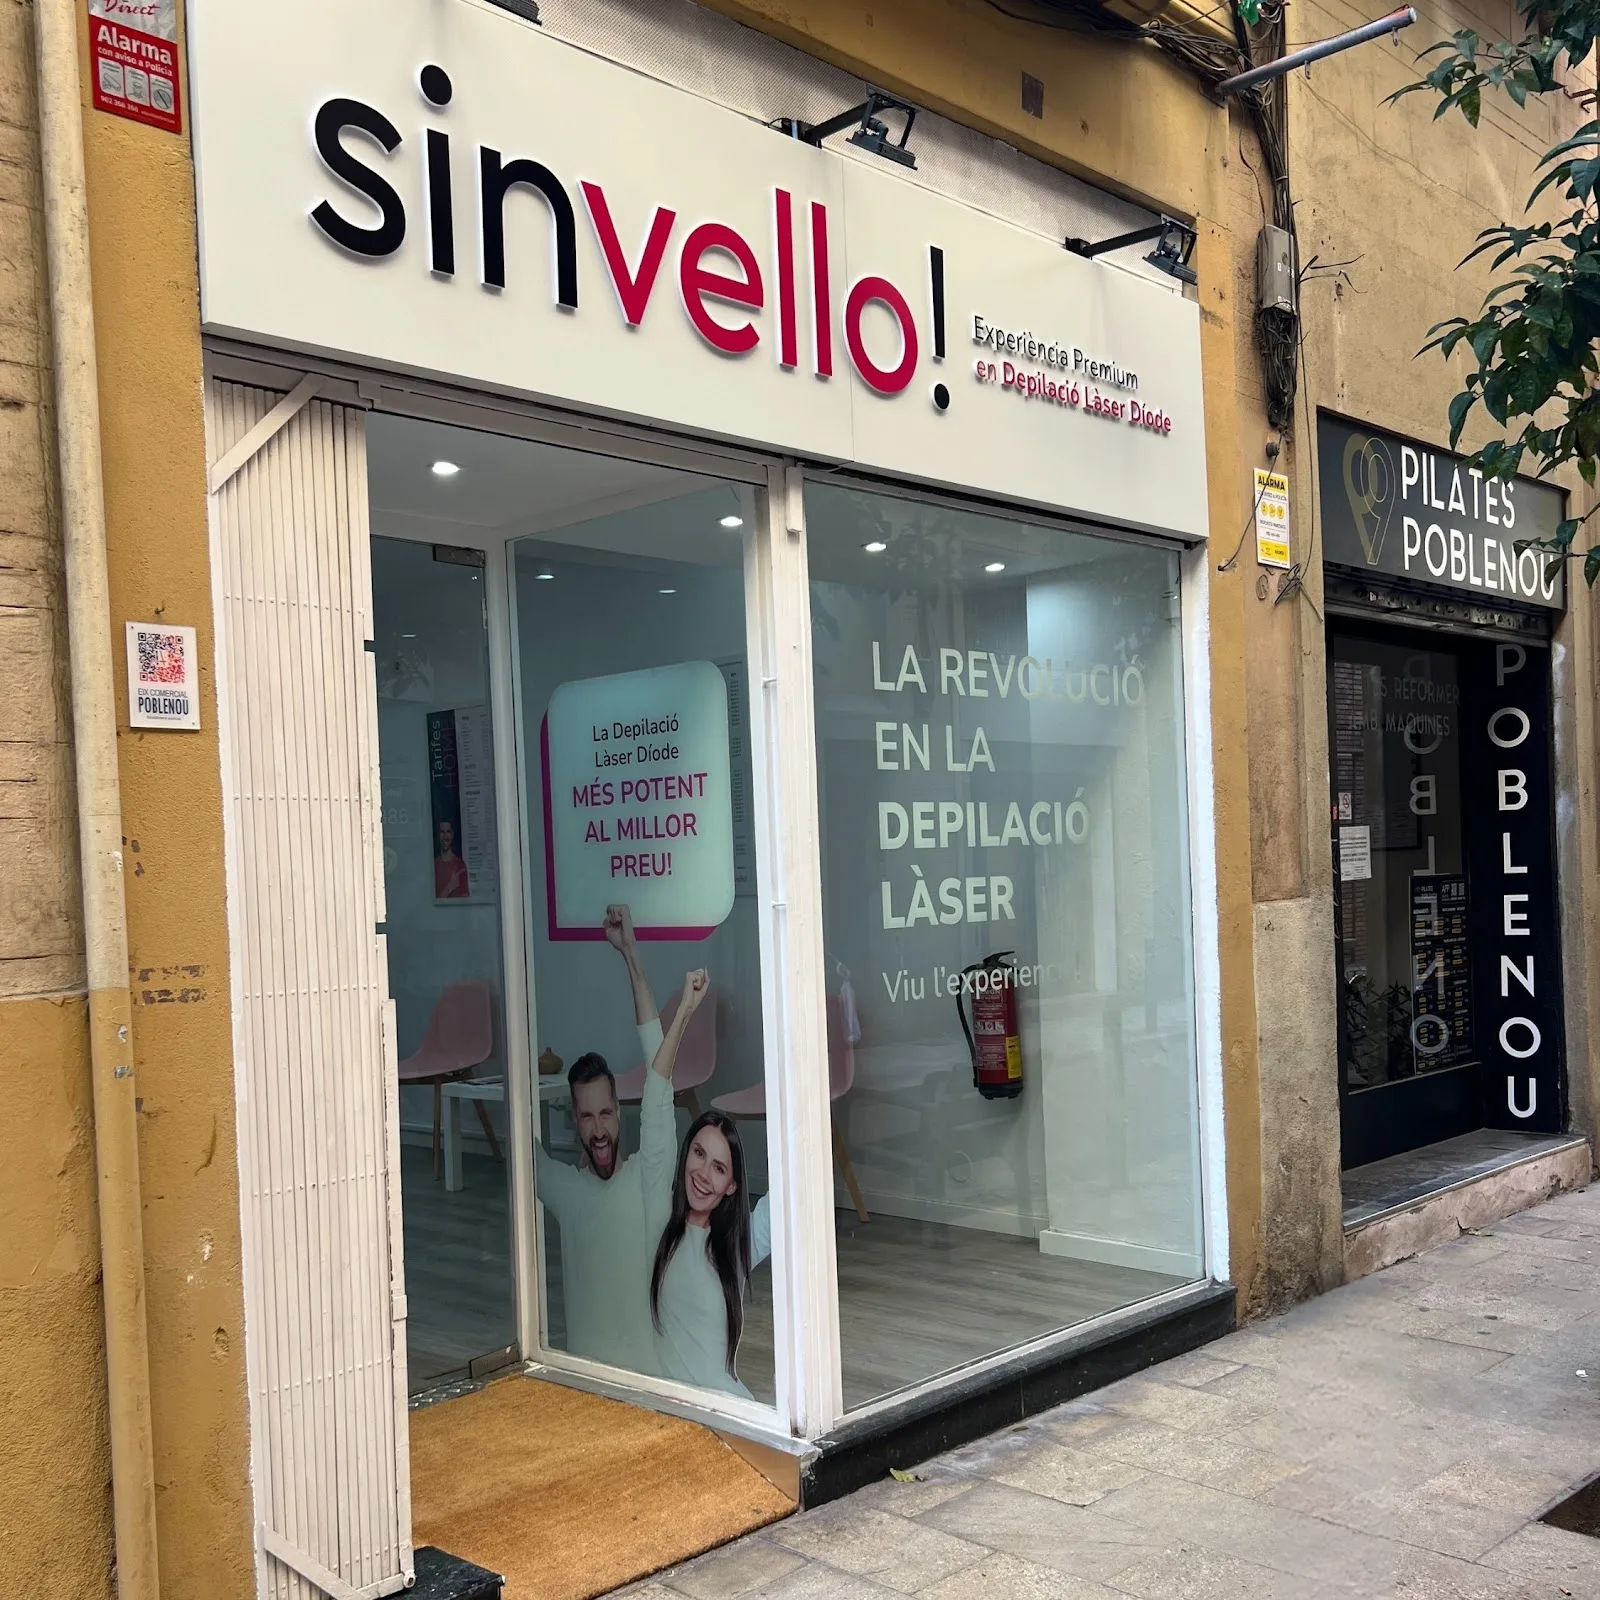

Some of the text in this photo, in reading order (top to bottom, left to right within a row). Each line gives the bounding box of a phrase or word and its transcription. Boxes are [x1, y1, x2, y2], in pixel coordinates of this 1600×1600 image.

[97, 24, 172, 66] Alarma
[97, 46, 113, 57] con
[114, 52, 137, 66] aviso
[138, 60, 144, 68] a
[309, 64, 951, 413] sinvello!
[973, 314, 1139, 391] Experiència Premium
[976, 359, 1173, 433] en Depilació Làser Díode
[1257, 474, 1286, 492] ALARMA
[1401, 445, 1516, 529] PILATES
[1402, 515, 1555, 601] POBLENOU
[138, 688, 188, 698] EIX COMERCIAL
[872, 641, 1145, 707] LA REVOLUCIÓ
[1394, 677, 1460, 705] REFORMER
[138, 697, 189, 715] POBLENOU
[593, 713, 680, 742] La Depilació
[876, 721, 996, 773] EN LA
[430, 719, 443, 783] Tarifes
[595, 742, 680, 768] Làser Díode
[573, 772, 708, 808] MÉS POTENT
[585, 812, 698, 843] AL MILLOR
[878, 786, 1092, 850] DEPILACIÓ
[610, 852, 672, 878] PREU!
[1487, 643, 1542, 1119] POBLENOU
[881, 864, 1016, 929] LÀSER
[881, 970, 926, 1004] Viu
